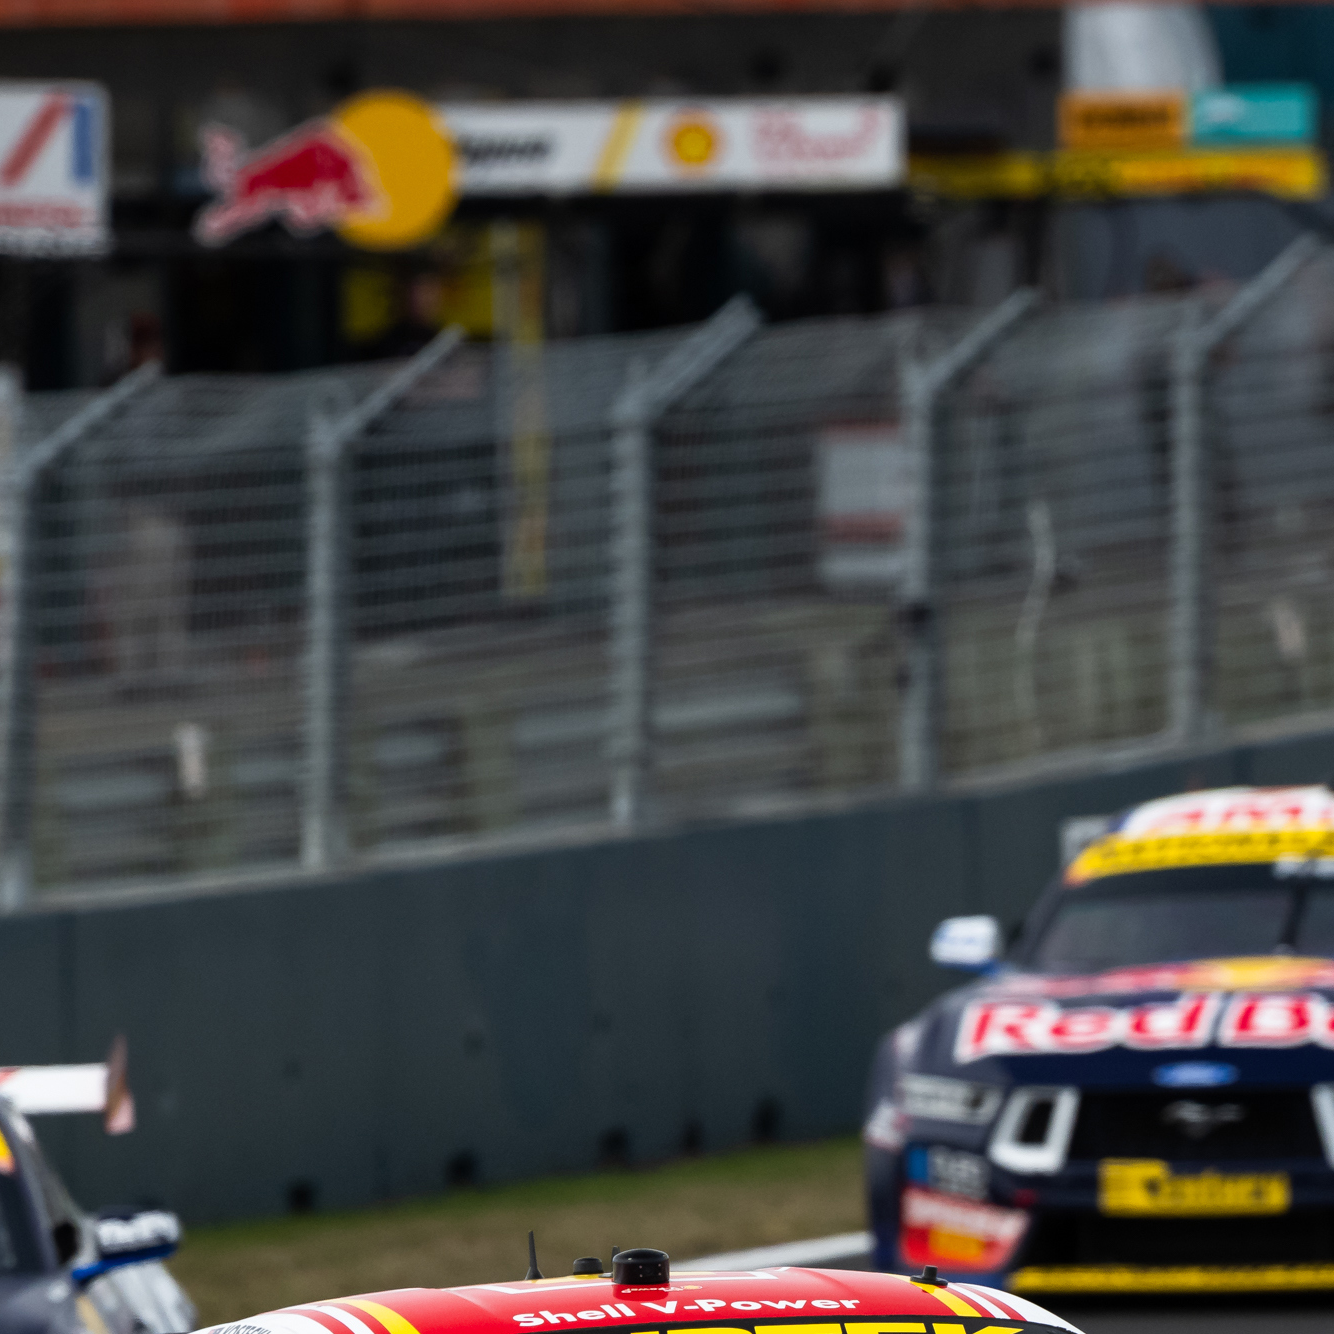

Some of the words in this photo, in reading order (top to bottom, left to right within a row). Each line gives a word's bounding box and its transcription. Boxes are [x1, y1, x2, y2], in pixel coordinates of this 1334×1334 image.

[954, 990, 1224, 1064] Red
[513, 1303, 637, 1328] Shell
[640, 1297, 861, 1316] V-Power
